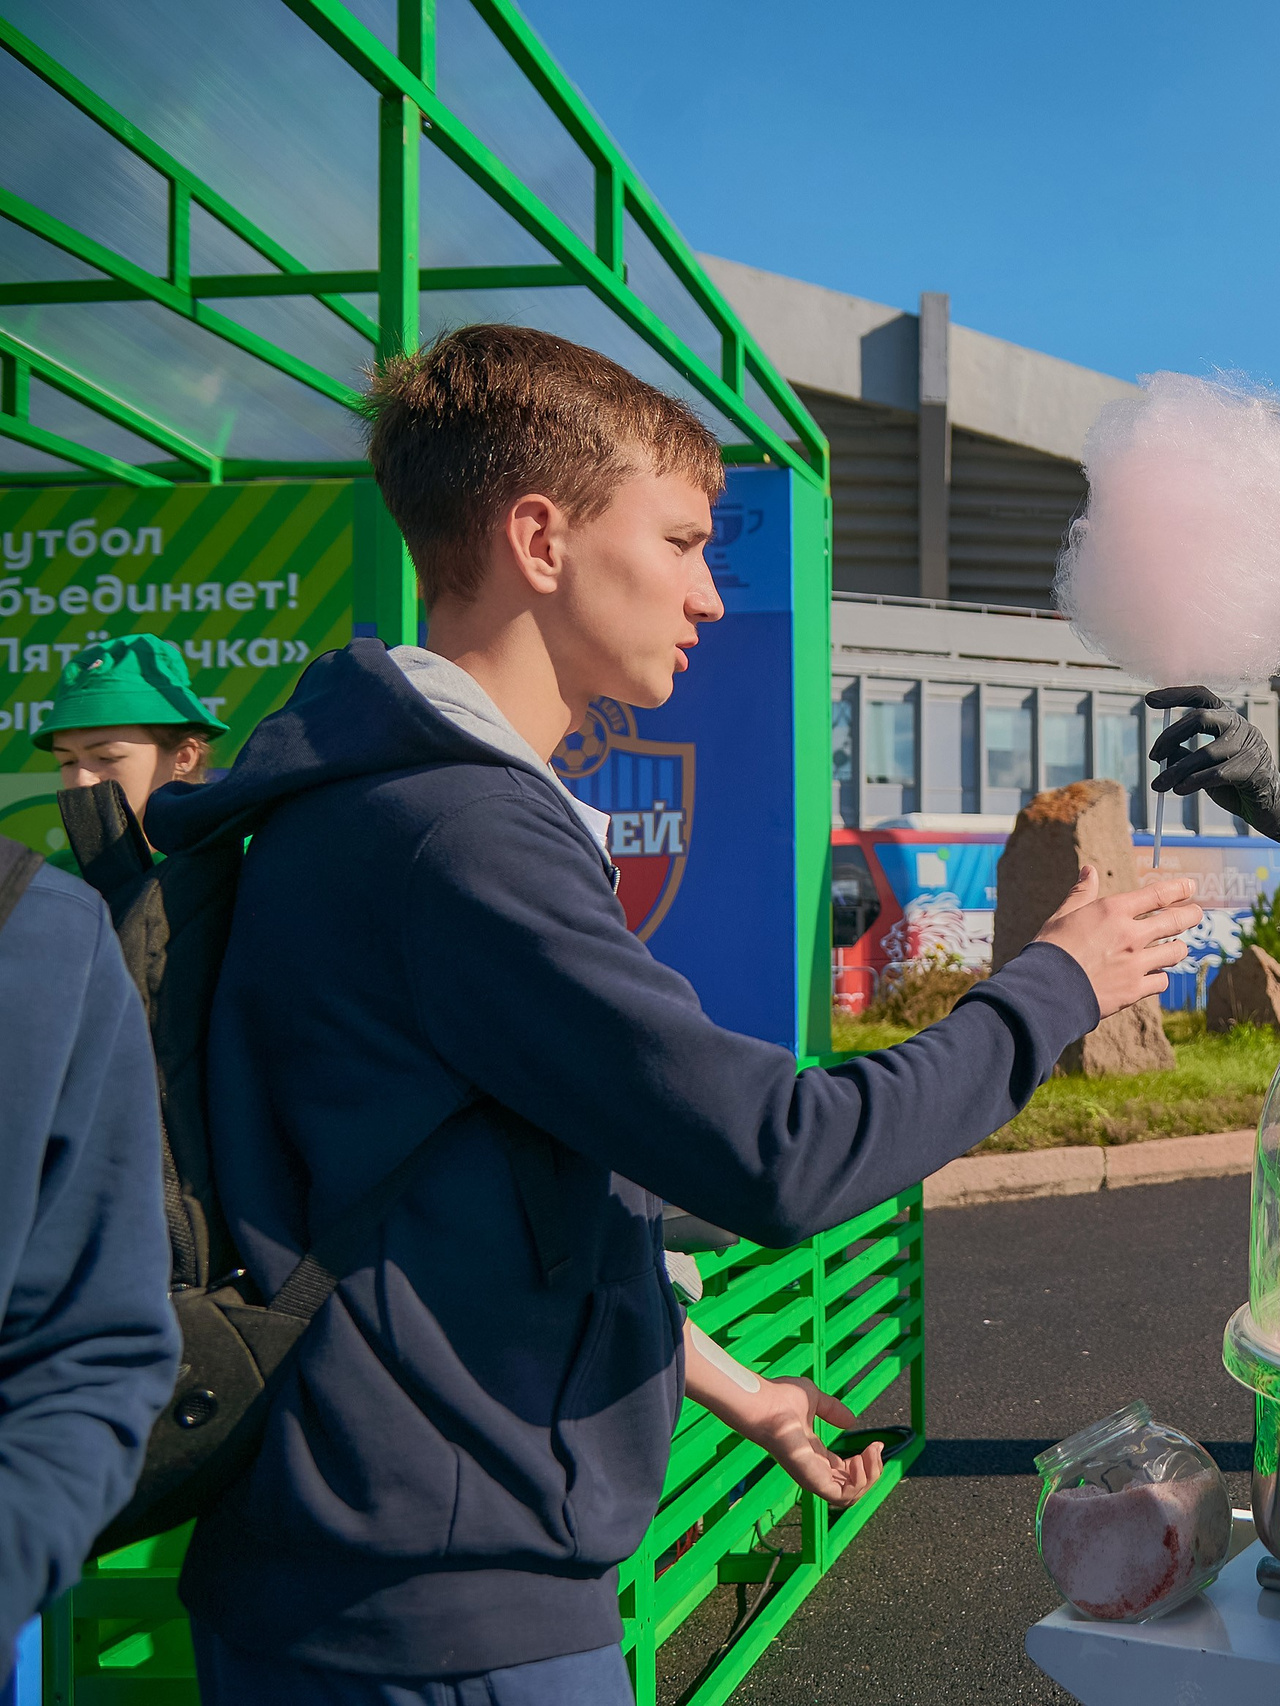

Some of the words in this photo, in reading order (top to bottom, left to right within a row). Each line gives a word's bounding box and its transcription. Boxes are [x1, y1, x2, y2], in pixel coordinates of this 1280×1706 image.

[0, 518, 163, 570] утбол
[0, 572, 299, 617] бъединяет!
[0, 629, 310, 675] Пятчка»
[609, 800, 684, 856] ЕЙ
